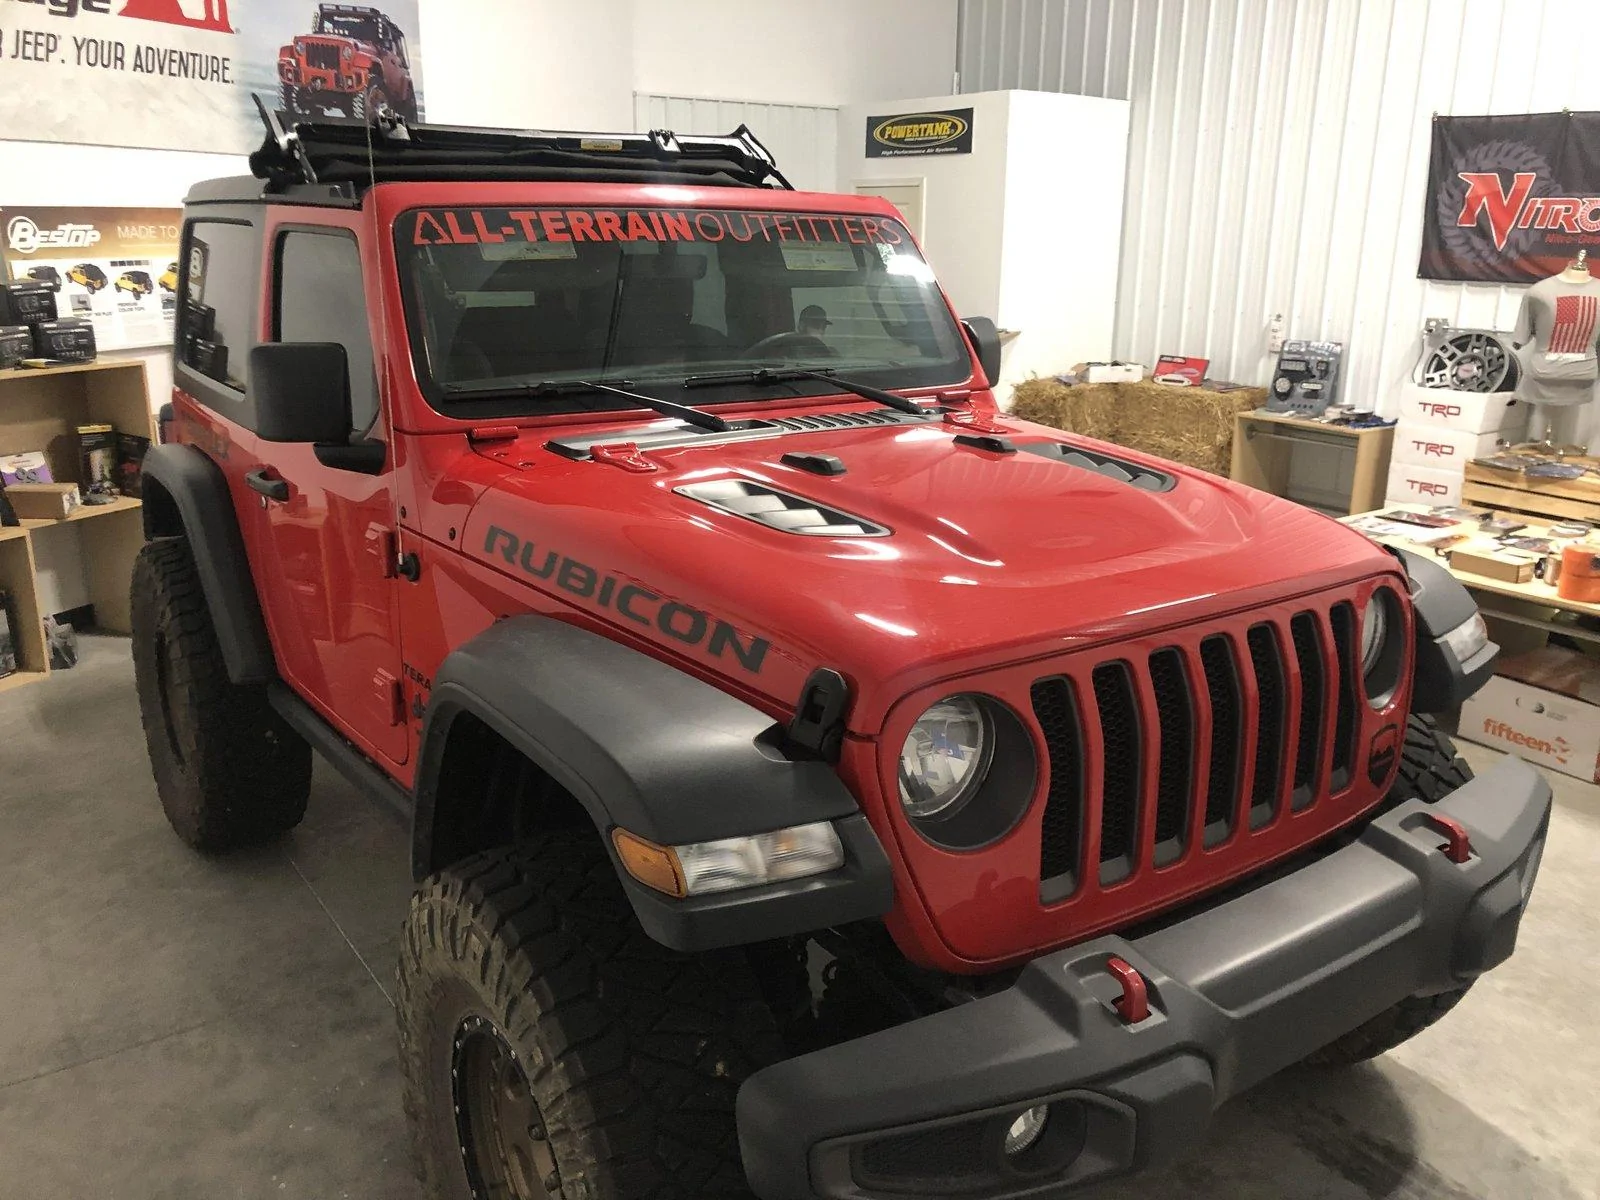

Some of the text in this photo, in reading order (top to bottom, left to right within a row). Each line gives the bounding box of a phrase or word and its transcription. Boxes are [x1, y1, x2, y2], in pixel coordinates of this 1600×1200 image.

[73, 36, 125, 70] YOUR
[133, 44, 235, 84] ADVENTURE.
[884, 121, 952, 139] POWERTANK
[117, 225, 179, 239] MADE TO
[413, 210, 902, 245] ALL-TERRAIN OUTFITTERS
[1418, 401, 1461, 418] TRD
[1411, 440, 1455, 458] TRD
[1405, 479, 1449, 496] TRD
[483, 524, 771, 675] RUBICON
[1483, 718, 1552, 755] fifteen
